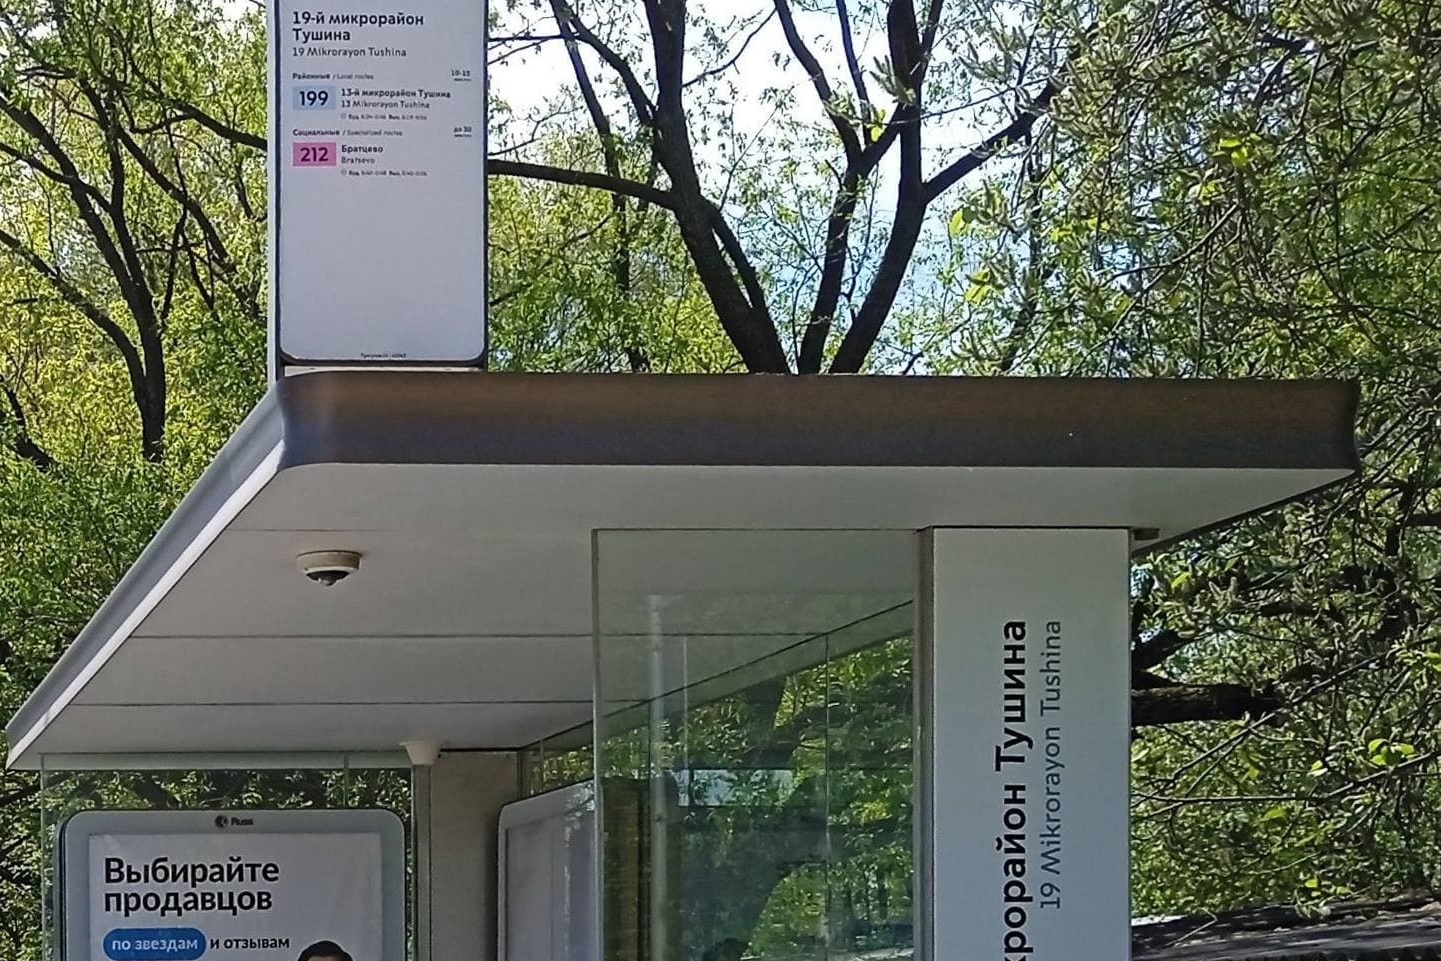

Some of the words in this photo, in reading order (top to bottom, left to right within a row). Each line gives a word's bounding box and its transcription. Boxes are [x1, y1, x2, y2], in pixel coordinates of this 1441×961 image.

[293, 11, 325, 25] 19-й
[329, 12, 424, 27] микрорайон
[292, 28, 351, 44] Тушина
[293, 47, 305, 57] 19
[307, 47, 366, 59] Mikrorayon
[368, 46, 407, 57] Tushina
[299, 90, 329, 106] 199
[341, 88, 360, 97] 13-й
[362, 88, 416, 98] микрорайон
[418, 89, 451, 99] Тушина
[341, 100, 351, 108] 13
[352, 100, 398, 110] Mikrorayon
[399, 100, 430, 109] Tushina
[300, 147, 329, 162] 212
[341, 144, 384, 154] Братцево
[1040, 620, 1061, 717] Tushina
[995, 620, 1033, 772] Тушина
[1040, 727, 1065, 874] Mikrorayon
[104, 856, 280, 888] Выбирайте
[104, 891, 273, 917] продавцов
[1040, 886, 1061, 909] 19
[112, 940, 131, 950] по
[134, 938, 198, 952] звездам
[210, 938, 219, 949] и
[223, 937, 290, 949] отзывам
